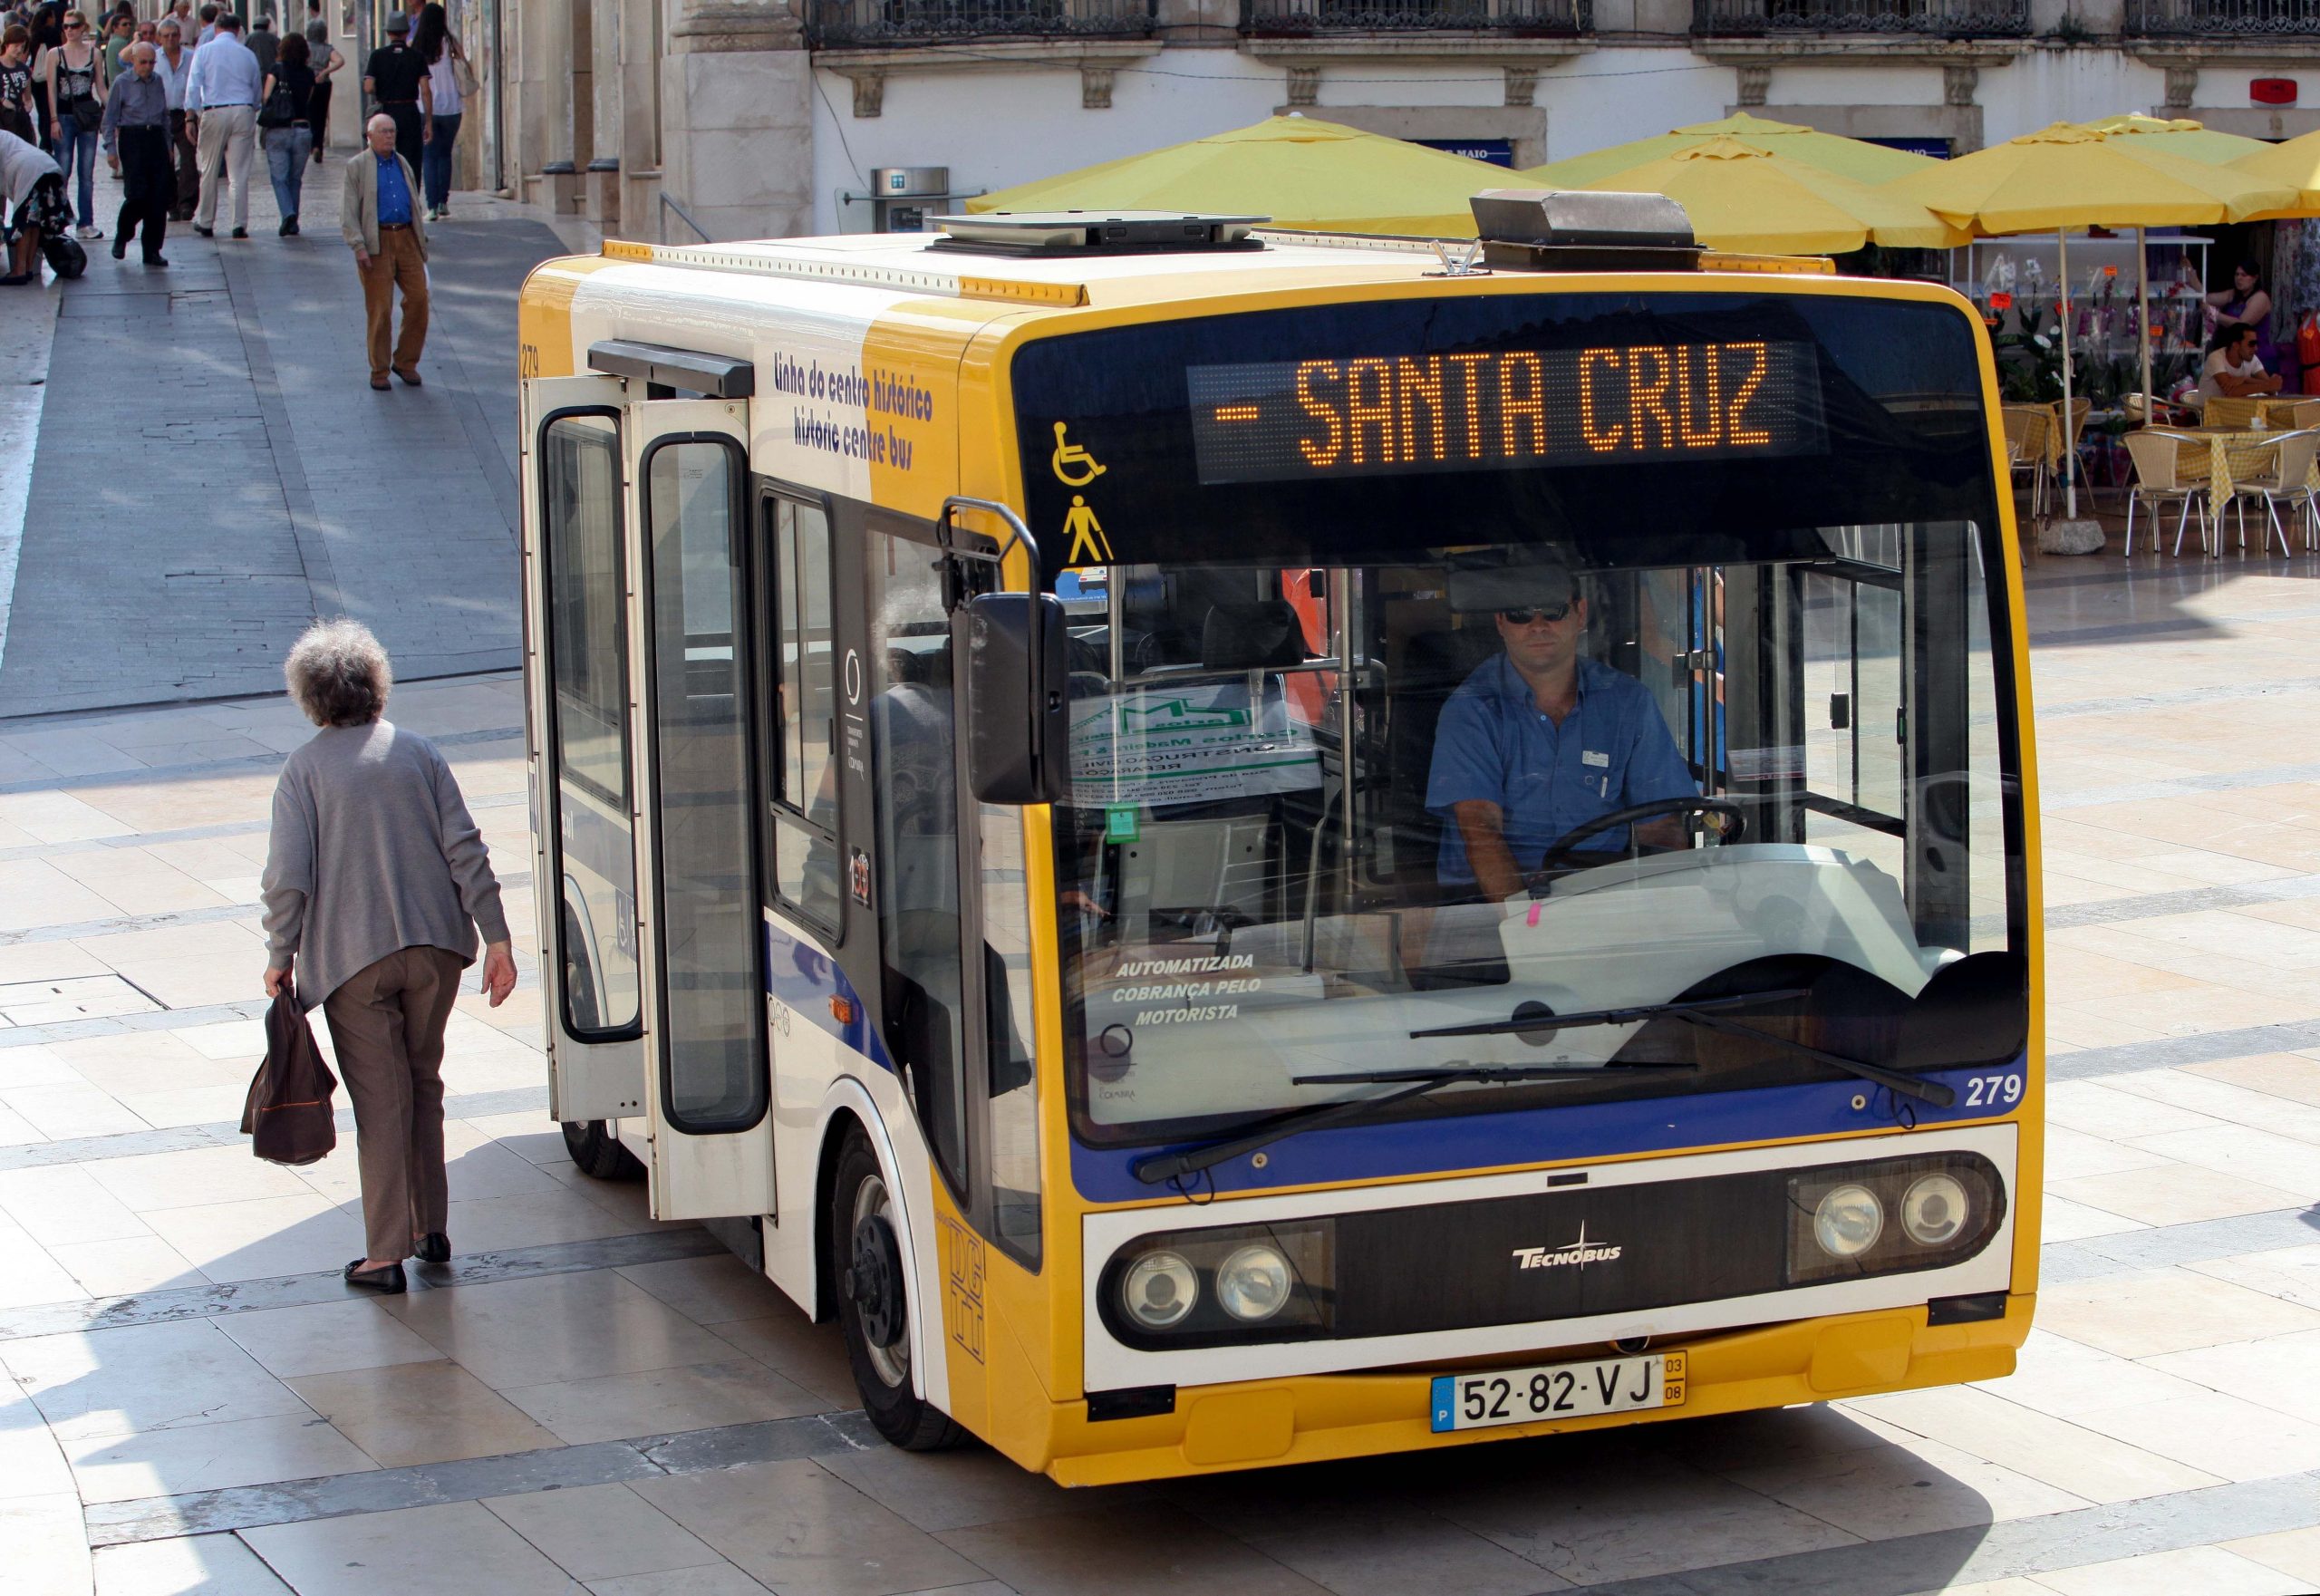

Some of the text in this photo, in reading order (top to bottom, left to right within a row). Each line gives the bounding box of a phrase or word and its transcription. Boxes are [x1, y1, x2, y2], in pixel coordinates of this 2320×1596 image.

[522, 343, 539, 379] 279
[809, 359, 825, 400] do
[828, 364, 870, 409] centro
[873, 369, 933, 422] histórico
[1297, 351, 1545, 466] SANTA
[1580, 342, 1769, 451] CRUZ
[793, 405, 913, 471] historic centre bus
[1116, 953, 1254, 978] AUTOMATIZADA
[1112, 978, 1262, 1002] COBRANÇA PELO
[1135, 1004, 1239, 1026] MOTORISTA
[1965, 1074, 2022, 1108] 279
[1666, 1359, 1682, 1373] 03
[1664, 1387, 1682, 1400] 08
[1438, 1409, 1448, 1422] P
